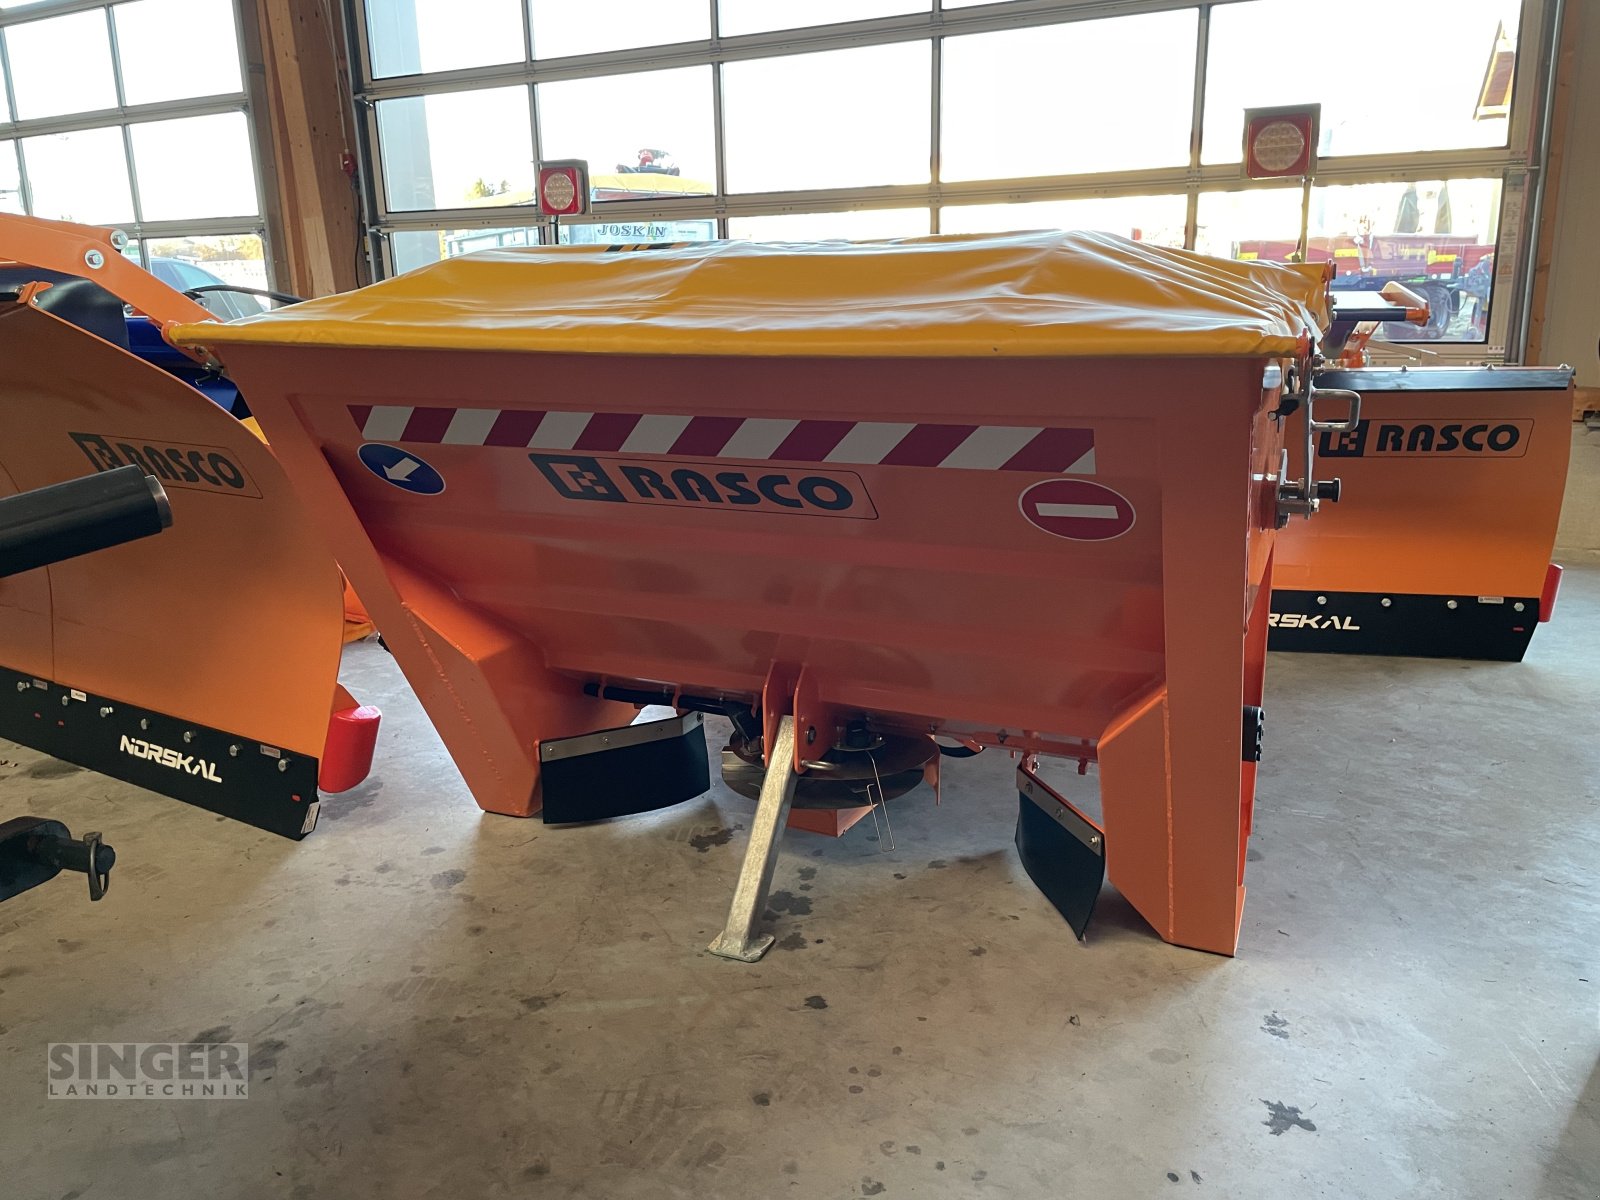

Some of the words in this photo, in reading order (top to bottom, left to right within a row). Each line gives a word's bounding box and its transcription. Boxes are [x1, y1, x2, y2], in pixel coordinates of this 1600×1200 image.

[597, 224, 666, 238] JOSKIN
[1375, 424, 1520, 452] RASCO
[116, 443, 245, 489] RASCO
[618, 465, 854, 511] RASCO
[1268, 613, 1360, 631] RSKAL
[119, 734, 223, 783] NORSKAL
